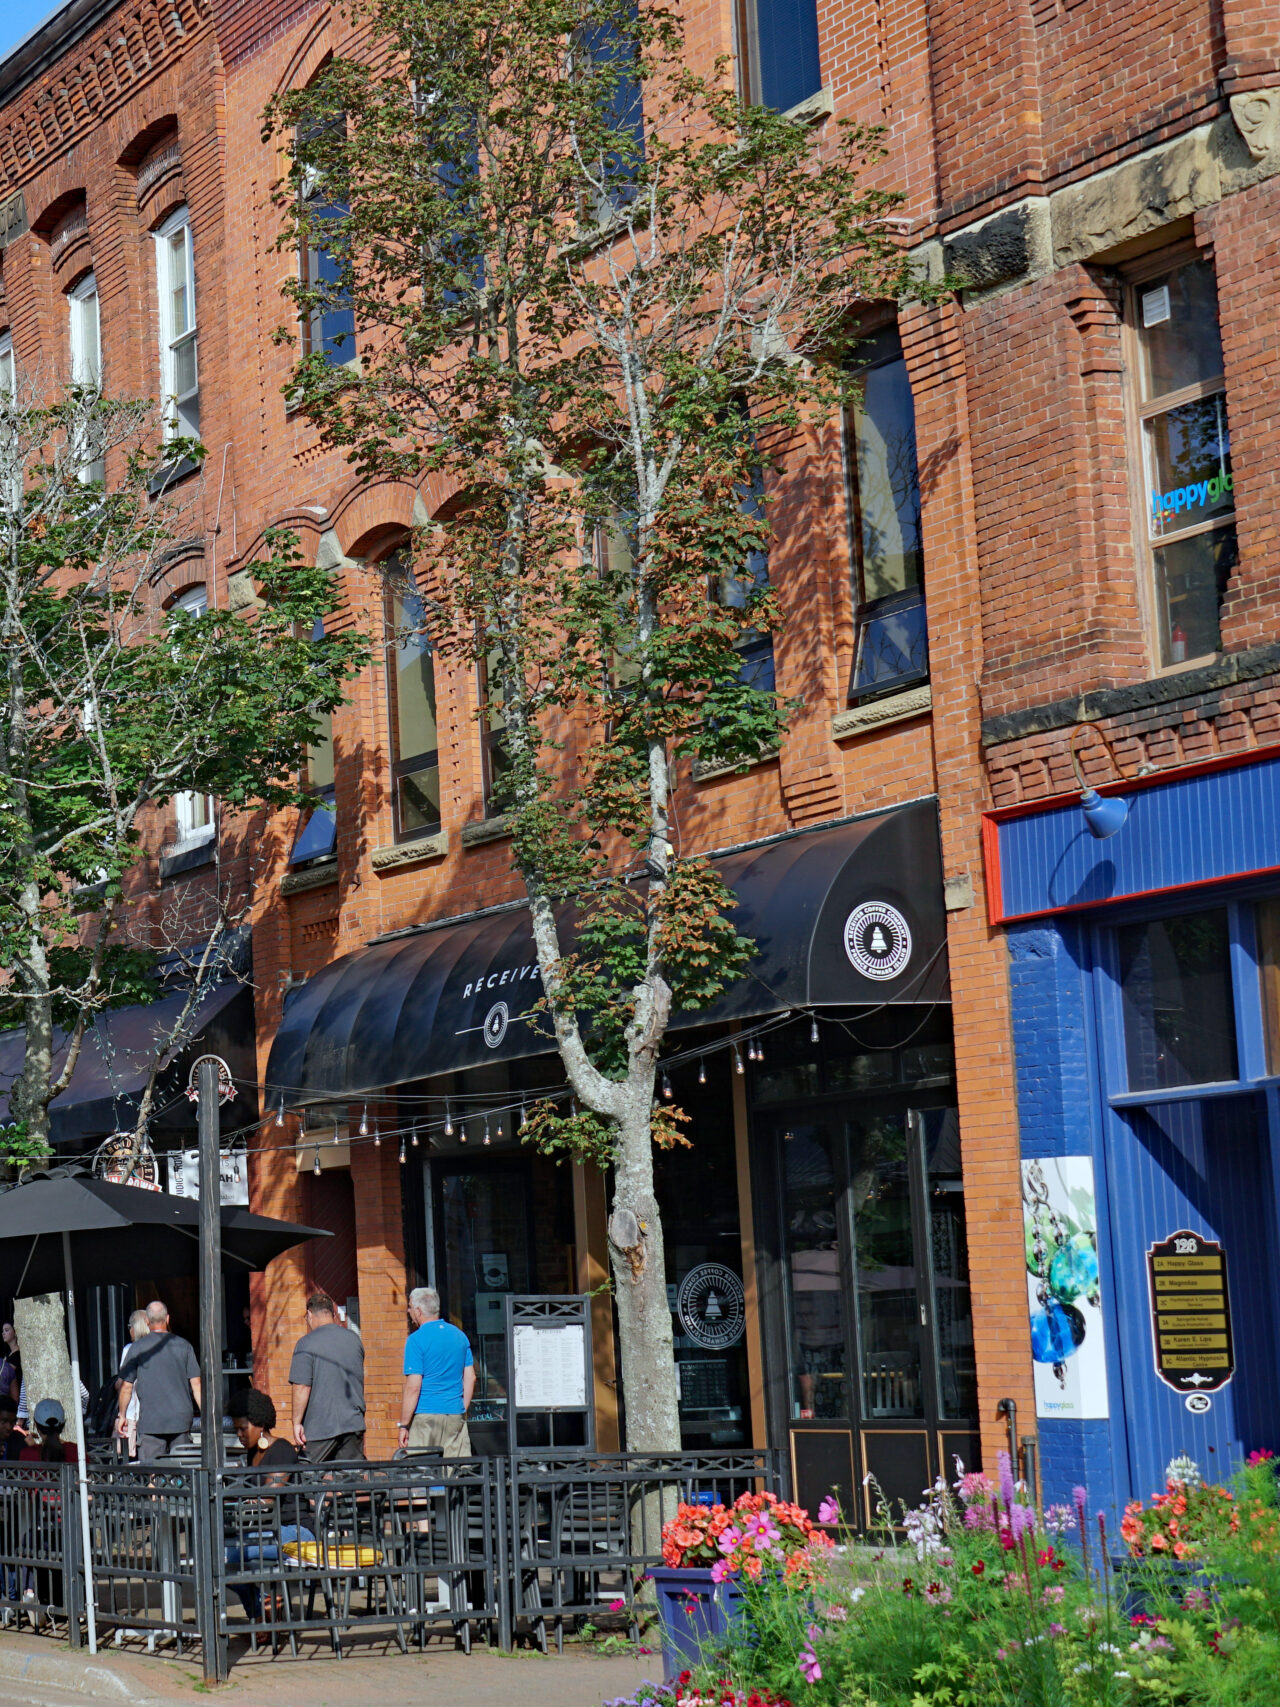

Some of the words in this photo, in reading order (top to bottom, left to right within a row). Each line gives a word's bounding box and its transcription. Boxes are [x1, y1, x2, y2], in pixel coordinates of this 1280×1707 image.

[1152, 469, 1234, 514] happygla
[848, 911, 864, 939] RECEIVER
[863, 906, 887, 914] COFFEE
[887, 910, 907, 939] COMPANY
[850, 948, 868, 971] PRINCE
[868, 966, 894, 976] EDWARD
[892, 947, 907, 970] ISLAND
[462, 964, 541, 999] RECEIVE
[1174, 1238, 1198, 1253] 126
